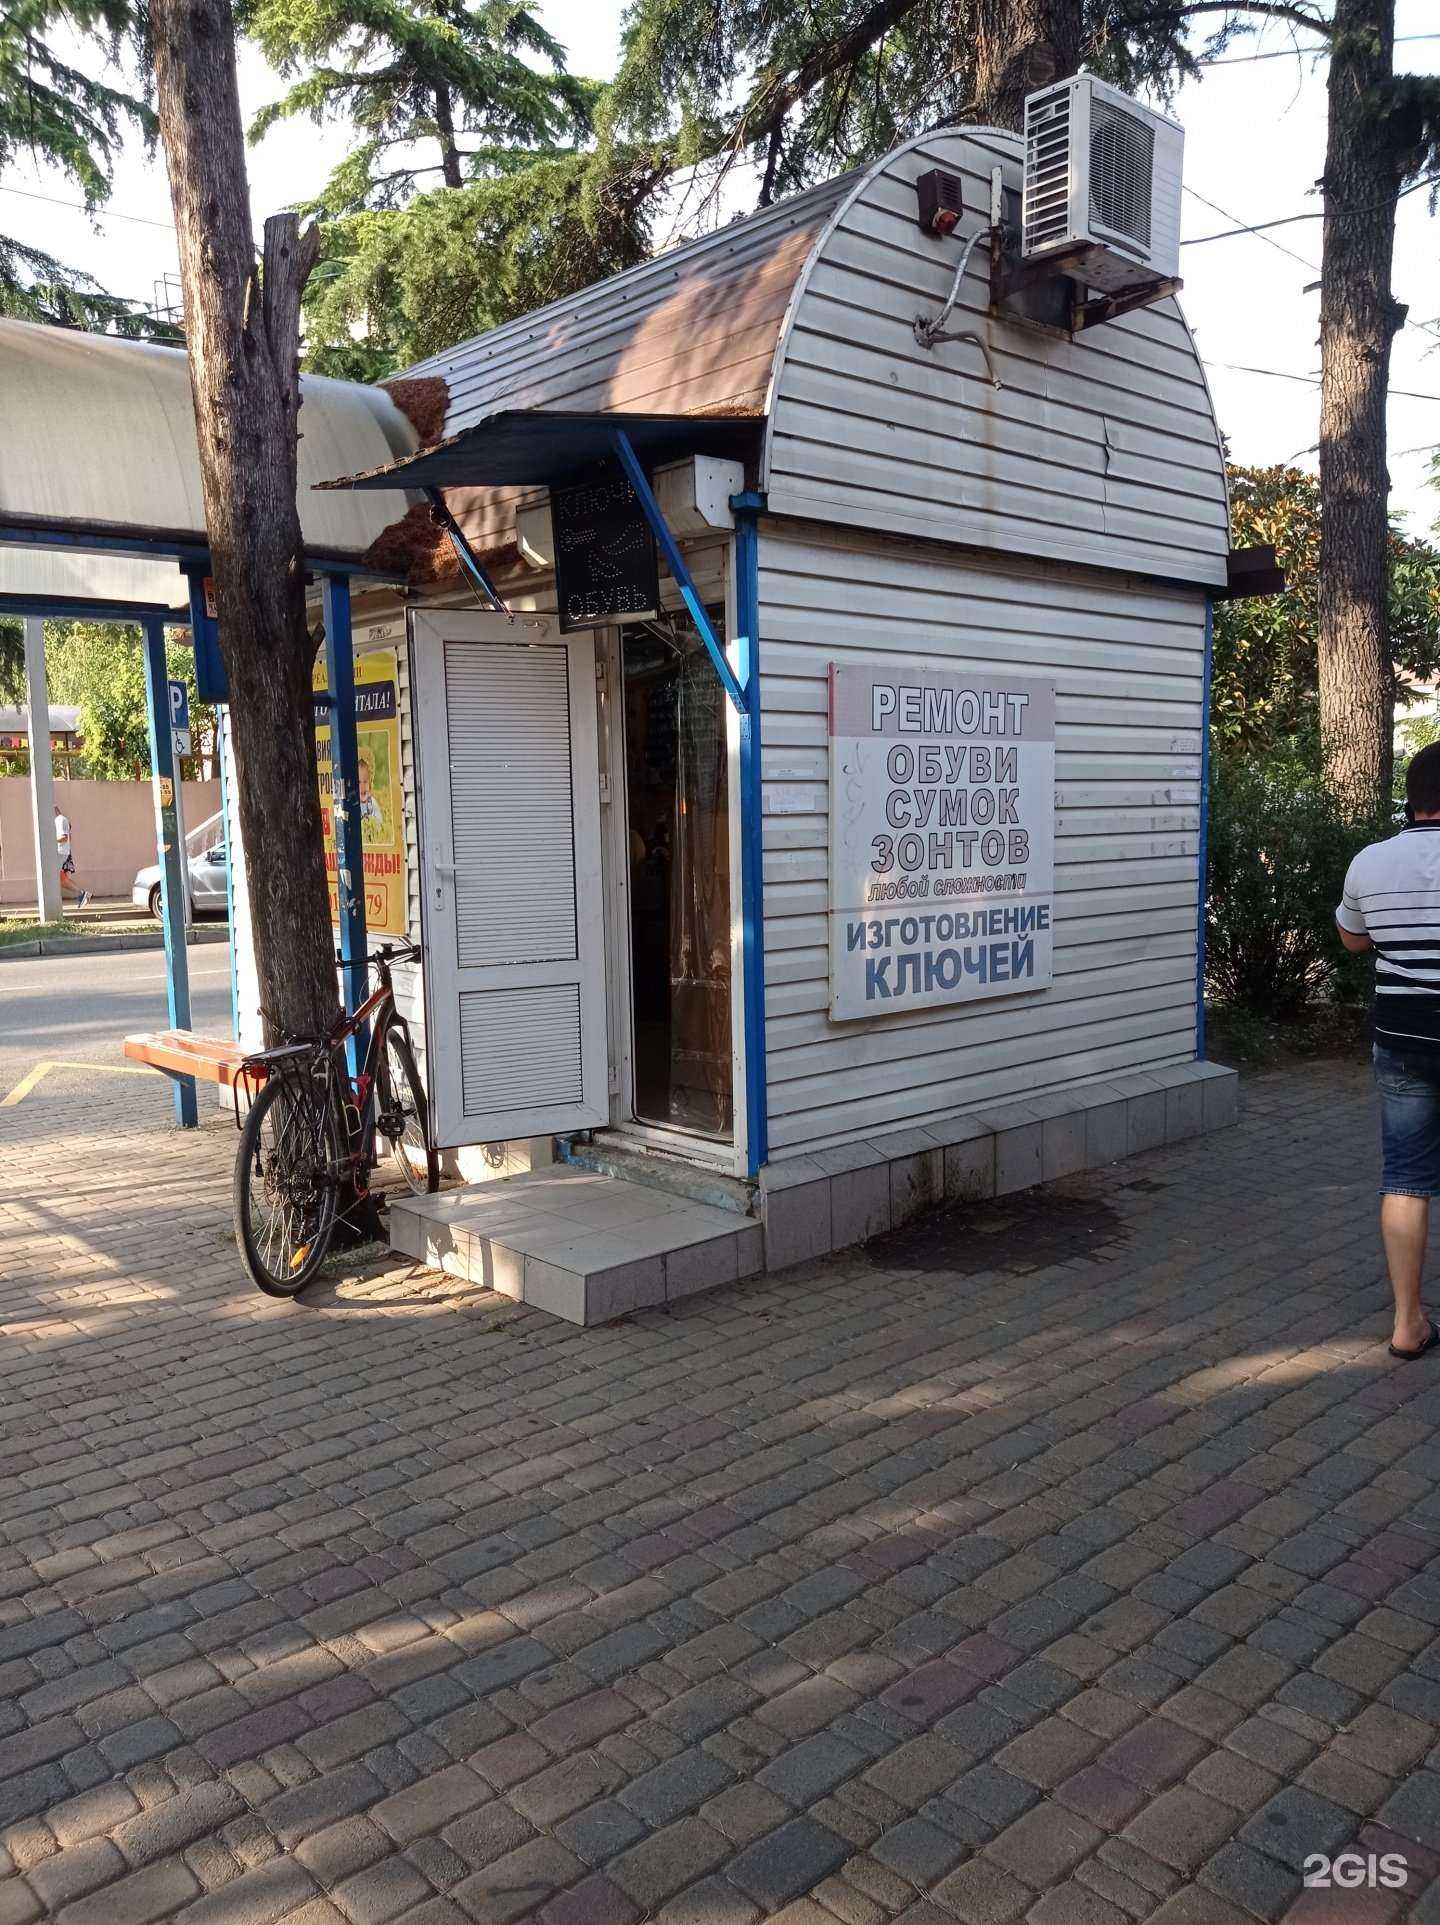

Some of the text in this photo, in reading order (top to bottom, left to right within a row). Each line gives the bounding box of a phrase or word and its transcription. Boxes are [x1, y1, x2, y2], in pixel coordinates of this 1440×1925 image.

[567, 584, 648, 620] ОБУВЬ
[169, 685, 183, 724] P
[871, 684, 1030, 736] РЕМОНТ
[886, 744, 1018, 785] ОБУВИ
[885, 788, 1020, 829] СУМОК
[870, 829, 1030, 874] ЗОНТОВ
[867, 872, 1027, 902] любой сложности
[846, 903, 1050, 952] ИЗГОТОВЛЕНИЕ
[864, 932, 1034, 1001] КЛЮЧЕЙ
